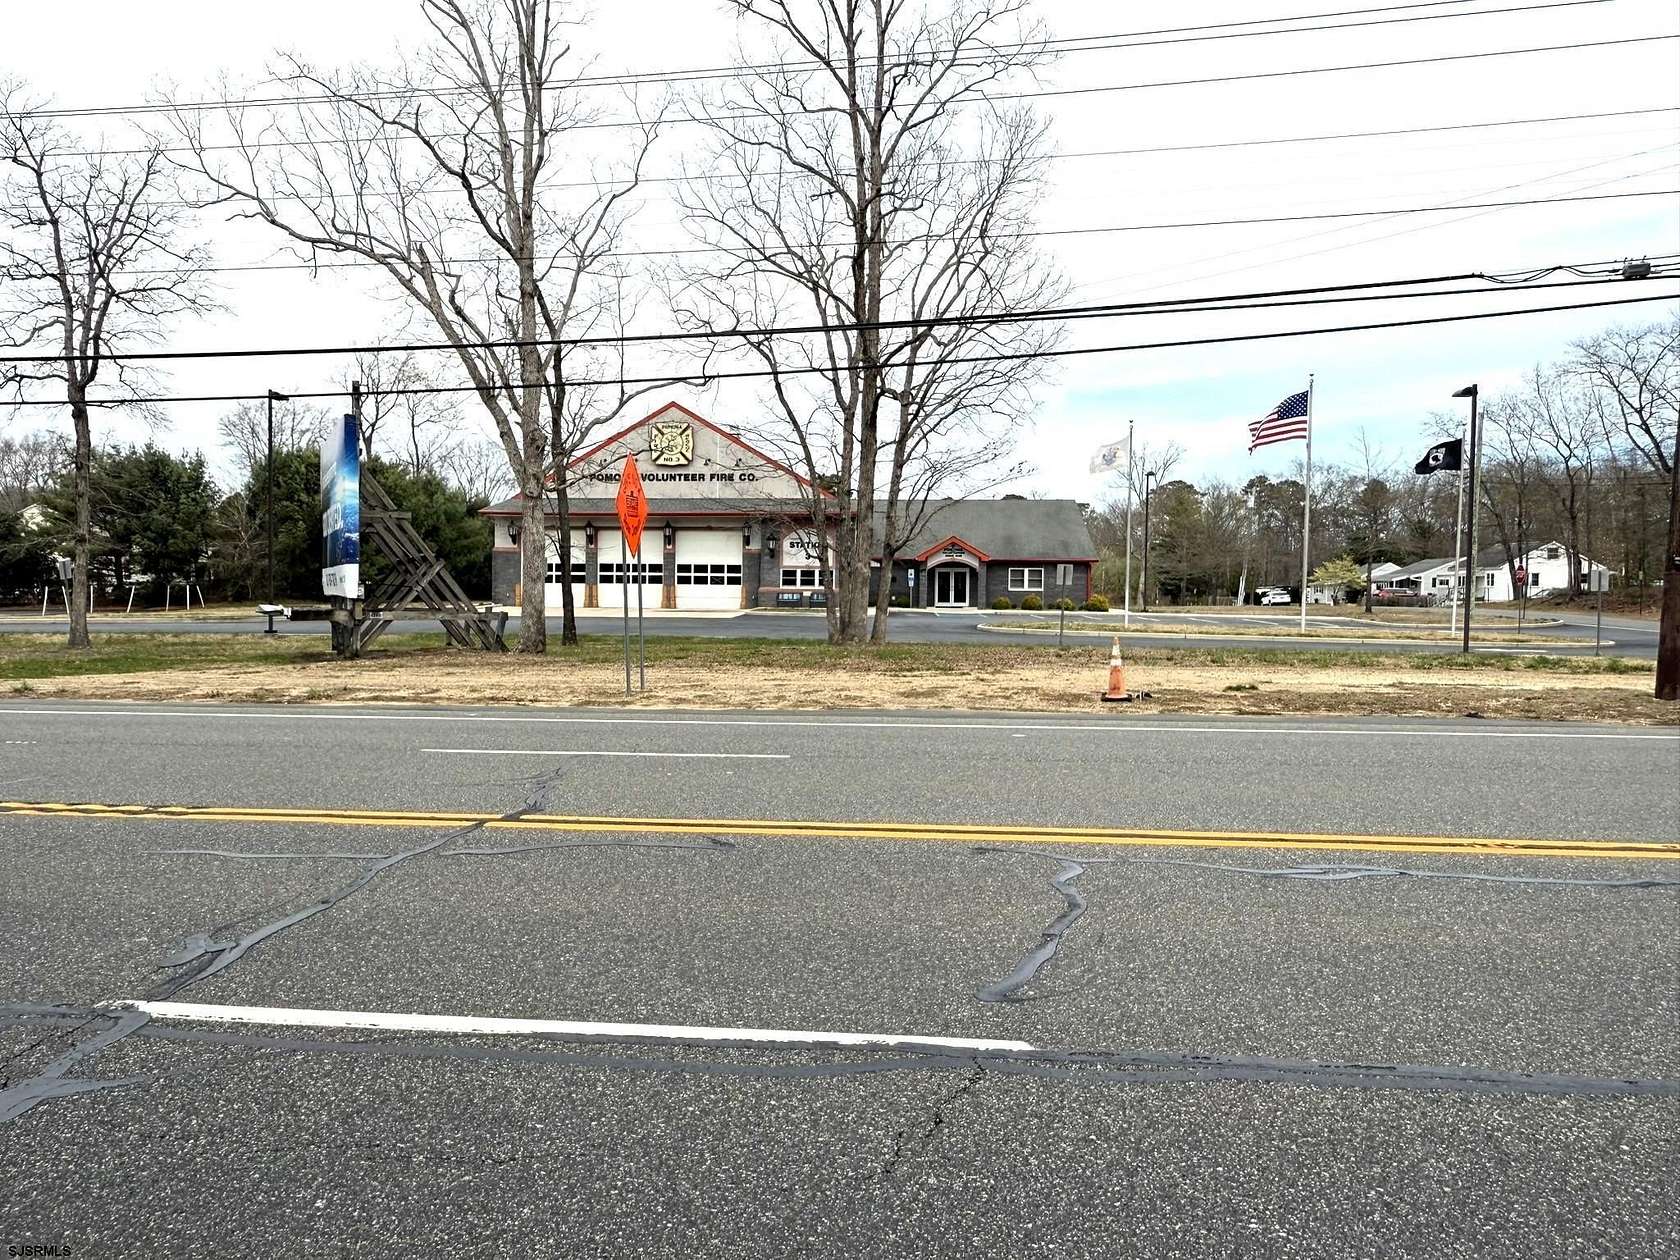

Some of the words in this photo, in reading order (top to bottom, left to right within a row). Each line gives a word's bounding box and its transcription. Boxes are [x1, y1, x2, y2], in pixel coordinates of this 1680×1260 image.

[589, 473, 621, 482] POMO
[641, 473, 705, 482] VOLUNTEER
[709, 473, 734, 482] FIRE
[738, 473, 758, 482] CO.
[789, 541, 820, 549] STATIO
[805, 552, 811, 560] 3
